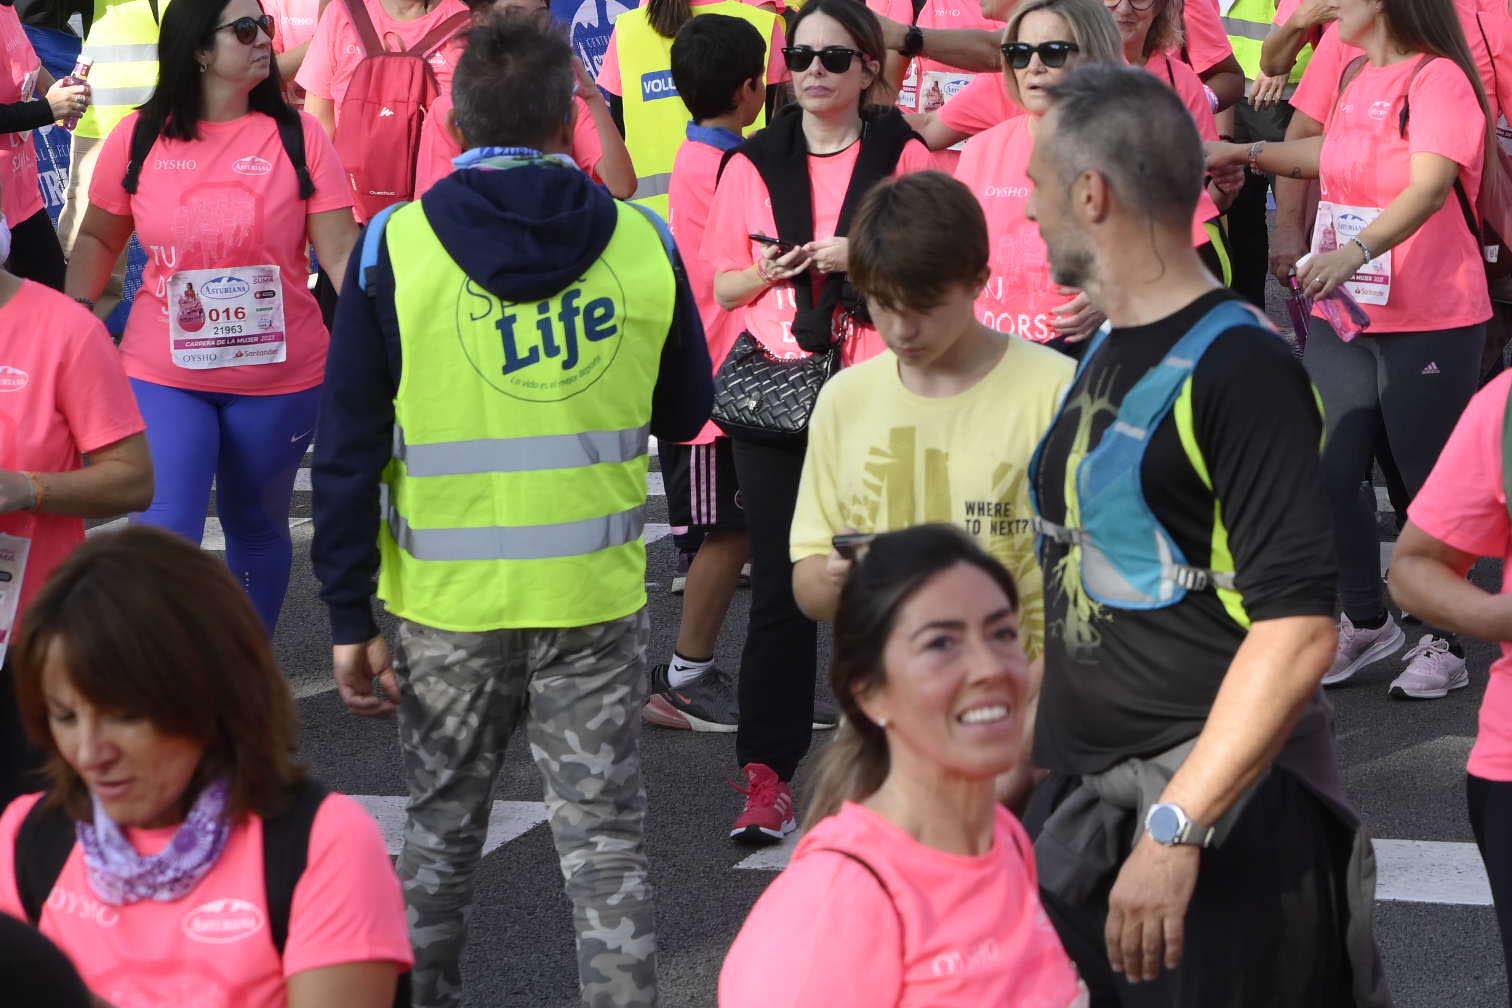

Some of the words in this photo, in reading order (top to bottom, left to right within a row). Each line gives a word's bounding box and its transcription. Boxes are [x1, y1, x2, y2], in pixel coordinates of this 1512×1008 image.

[150, 246, 176, 268] TU
[202, 283, 246, 295] ASTURIANA
[208, 307, 246, 322] 016
[213, 325, 243, 335] 21963
[496, 288, 618, 375] Life
[183, 353, 217, 363] OYSHO
[244, 348, 280, 357] Santander
[965, 501, 1012, 518] WHERE
[965, 519, 981, 535] TO
[990, 518, 1030, 536] NEXT?
